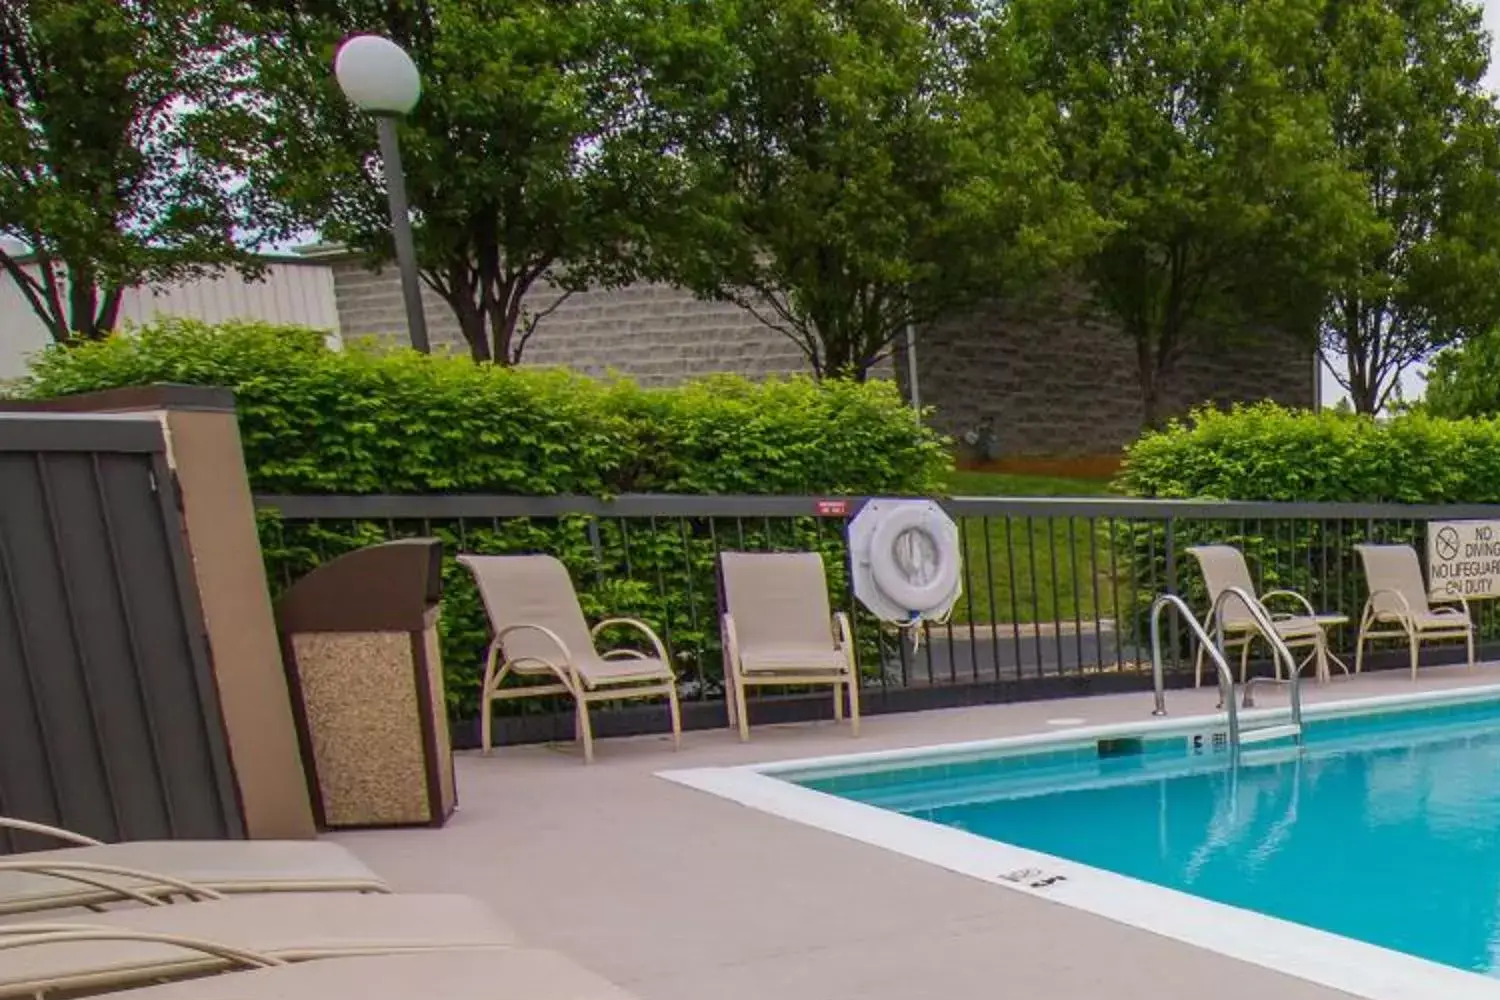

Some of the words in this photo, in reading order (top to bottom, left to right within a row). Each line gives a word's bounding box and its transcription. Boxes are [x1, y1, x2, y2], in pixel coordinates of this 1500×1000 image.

[1475, 526, 1493, 540] NO
[1431, 563, 1449, 579] NO
[1446, 580, 1462, 595] ON
[1465, 578, 1493, 594] DUTY
